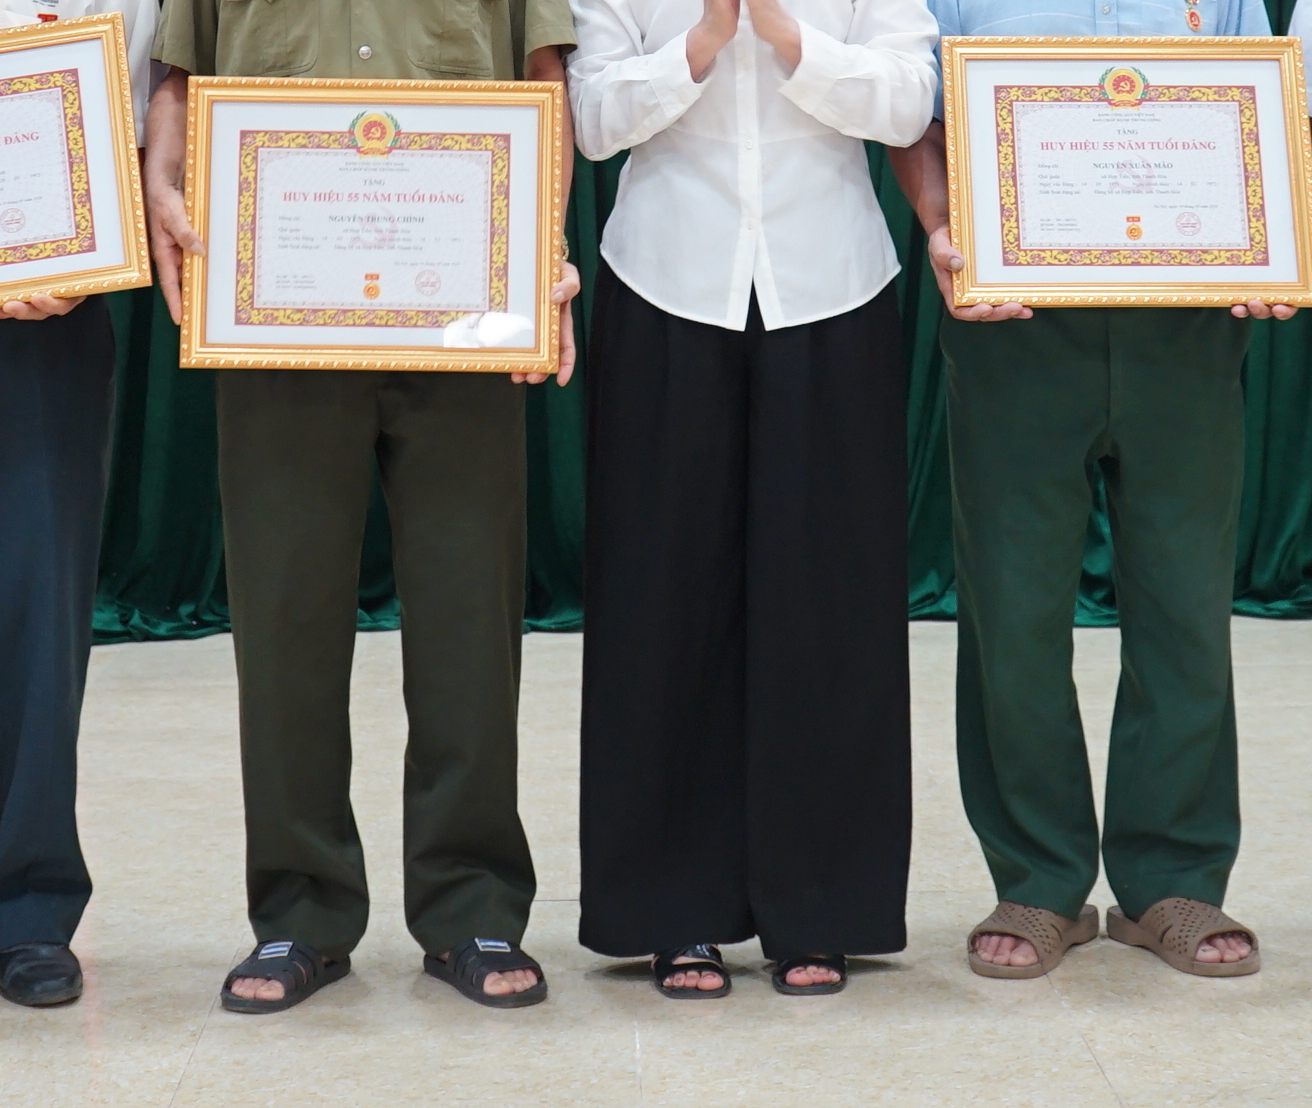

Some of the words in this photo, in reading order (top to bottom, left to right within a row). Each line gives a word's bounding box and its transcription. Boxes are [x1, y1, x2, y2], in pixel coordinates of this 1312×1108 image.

[4, 131, 40, 145] ĐẢNG
[1040, 142, 1067, 151] HUY
[1069, 139, 1101, 153] HIỆU
[1102, 141, 1115, 151] 55
[1117, 139, 1146, 151] NĂM
[1182, 139, 1217, 151] ĐẢNG
[282, 192, 310, 202] HUY
[312, 189, 344, 205] HIỆU
[347, 192, 360, 202] 55
[362, 190, 392, 203] NĂM
